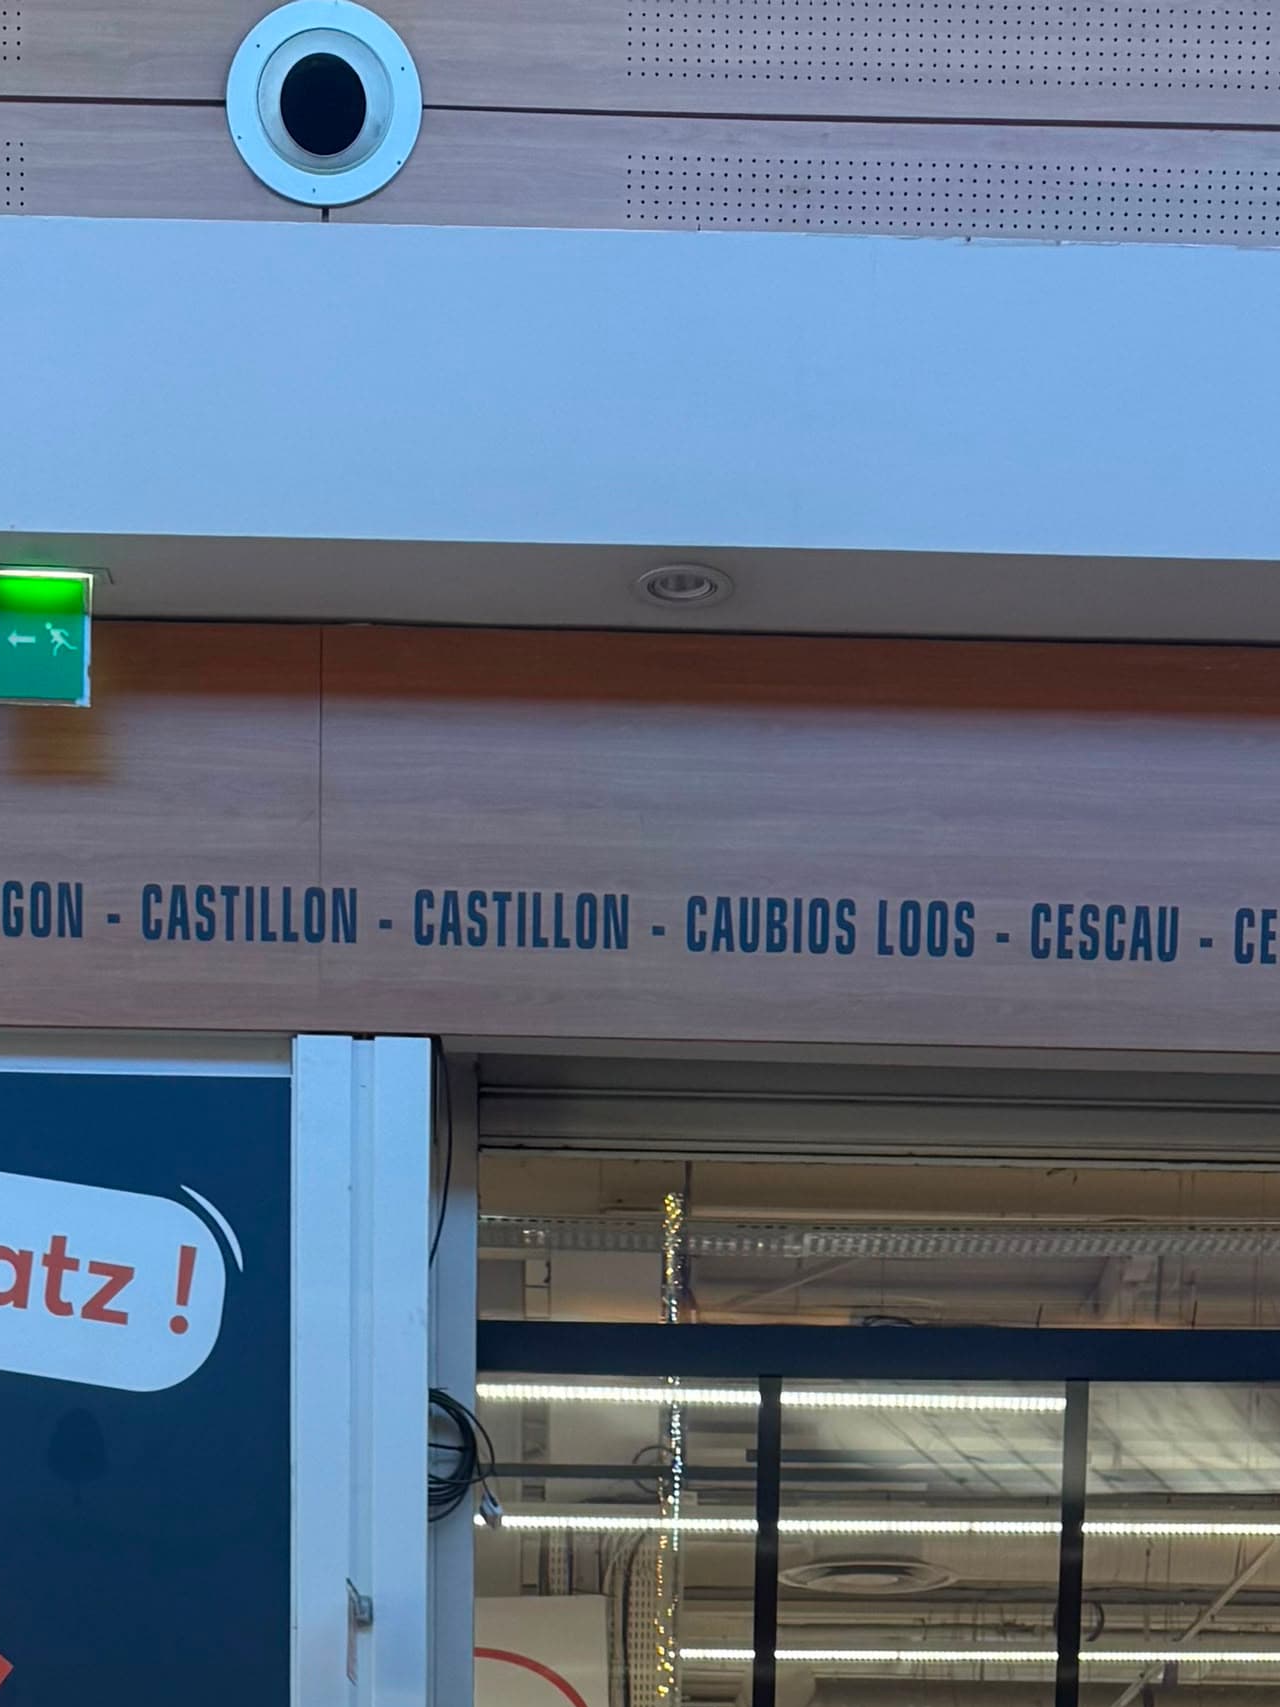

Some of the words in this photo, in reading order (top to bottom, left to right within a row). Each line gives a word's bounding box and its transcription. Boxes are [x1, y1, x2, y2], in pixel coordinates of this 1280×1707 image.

[142, 884, 358, 944] CASTILLON
[414, 889, 629, 950] CASTILLON
[687, 896, 856, 955] CAUBIOS
[877, 900, 975, 958] LOOS
[1031, 903, 1179, 963] CESCAU
[167, 1244, 200, 1335] !
